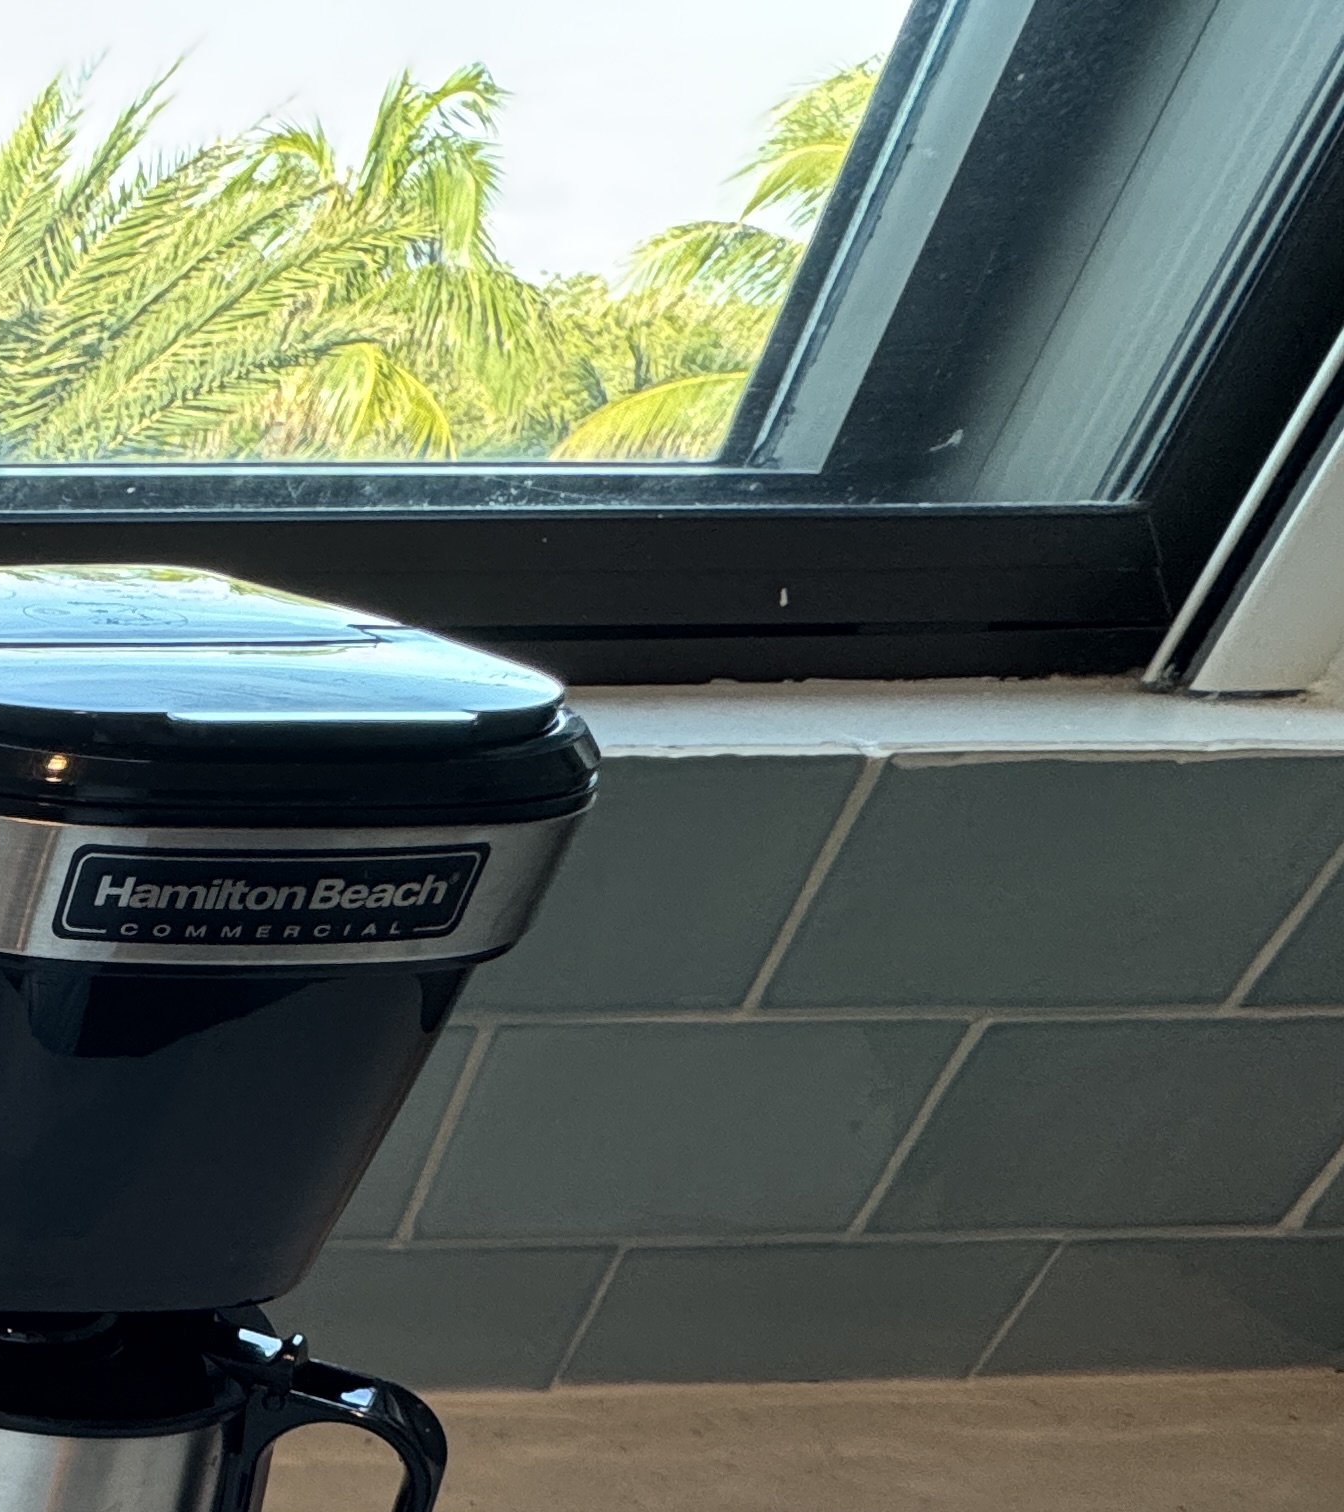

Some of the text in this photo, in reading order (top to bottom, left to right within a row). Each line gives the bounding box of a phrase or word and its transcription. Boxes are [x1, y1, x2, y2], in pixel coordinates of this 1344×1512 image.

[94, 873, 449, 911] Hamilton Beach
[120, 921, 402, 939] COMMERCIAL
